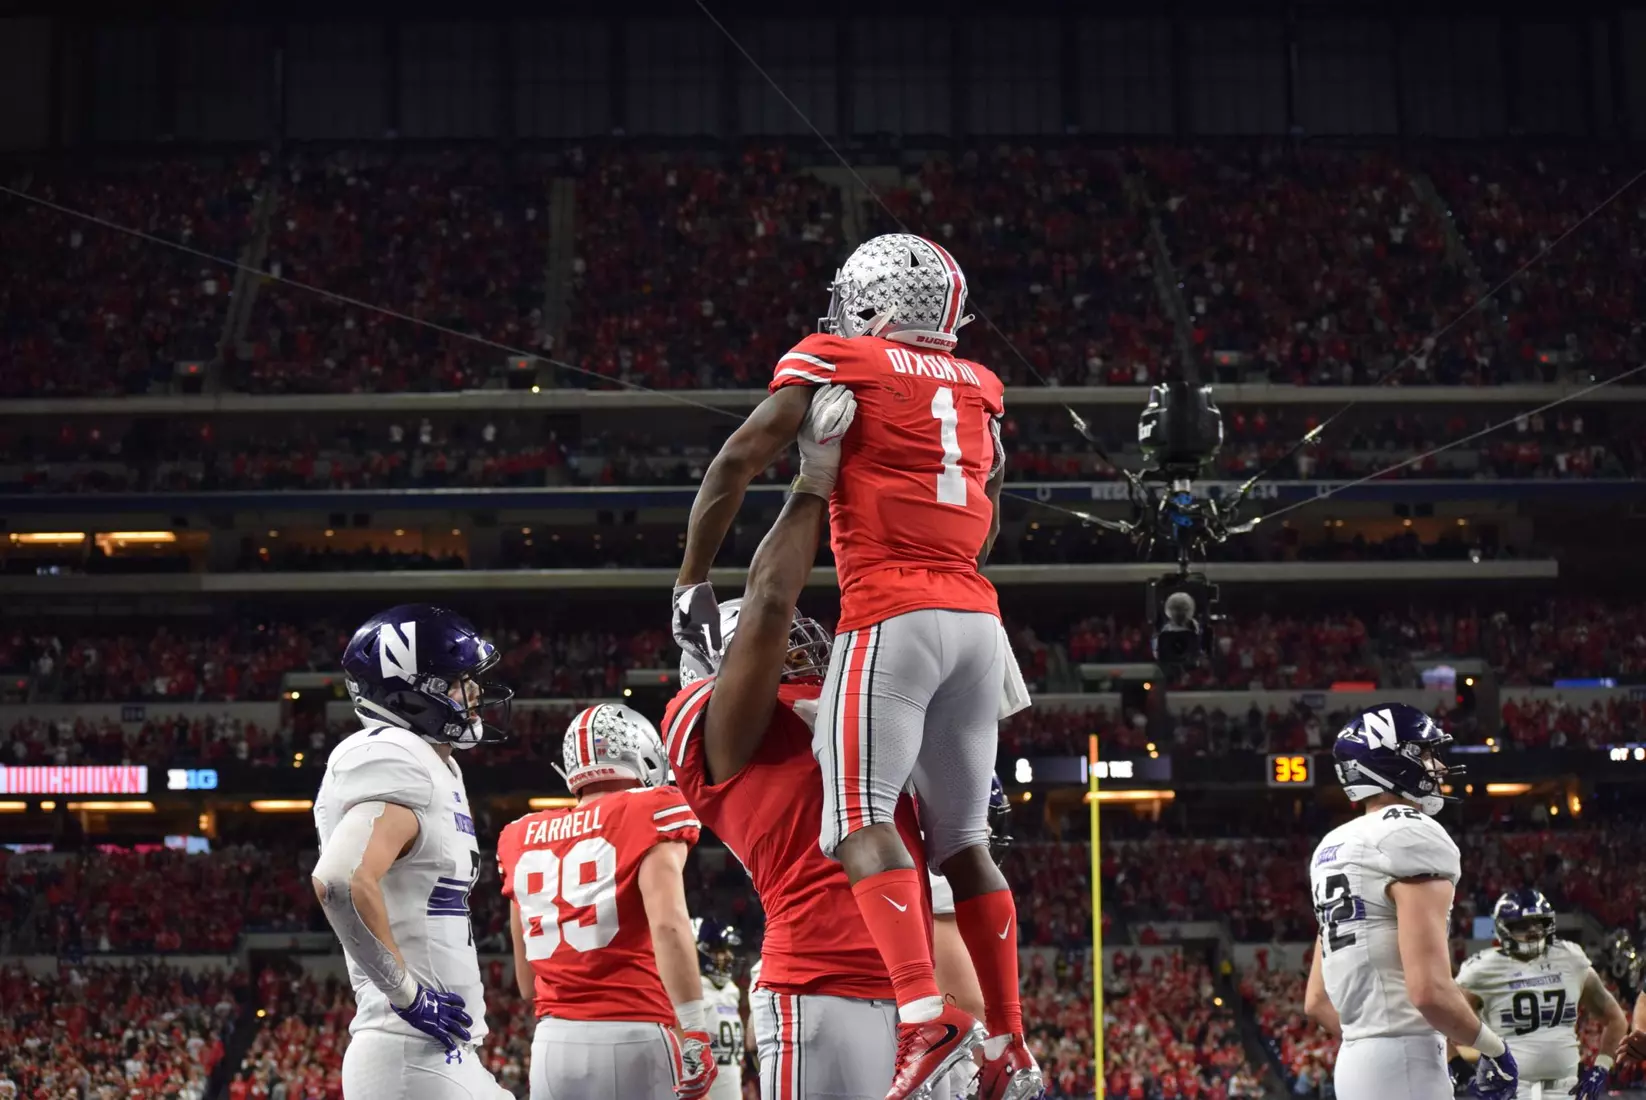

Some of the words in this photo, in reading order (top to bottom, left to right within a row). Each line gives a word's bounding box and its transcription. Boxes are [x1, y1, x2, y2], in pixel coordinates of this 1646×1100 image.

[885, 348, 958, 382] DIXON
[953, 361, 981, 387] III
[931, 386, 967, 507] 1
[379, 620, 418, 679] N
[1362, 708, 1398, 750] N
[1275, 756, 1308, 783] 35
[524, 808, 603, 845] FARRELL
[1382, 807, 1422, 821] 42
[513, 836, 620, 962] 89
[1512, 989, 1567, 1036] 97
